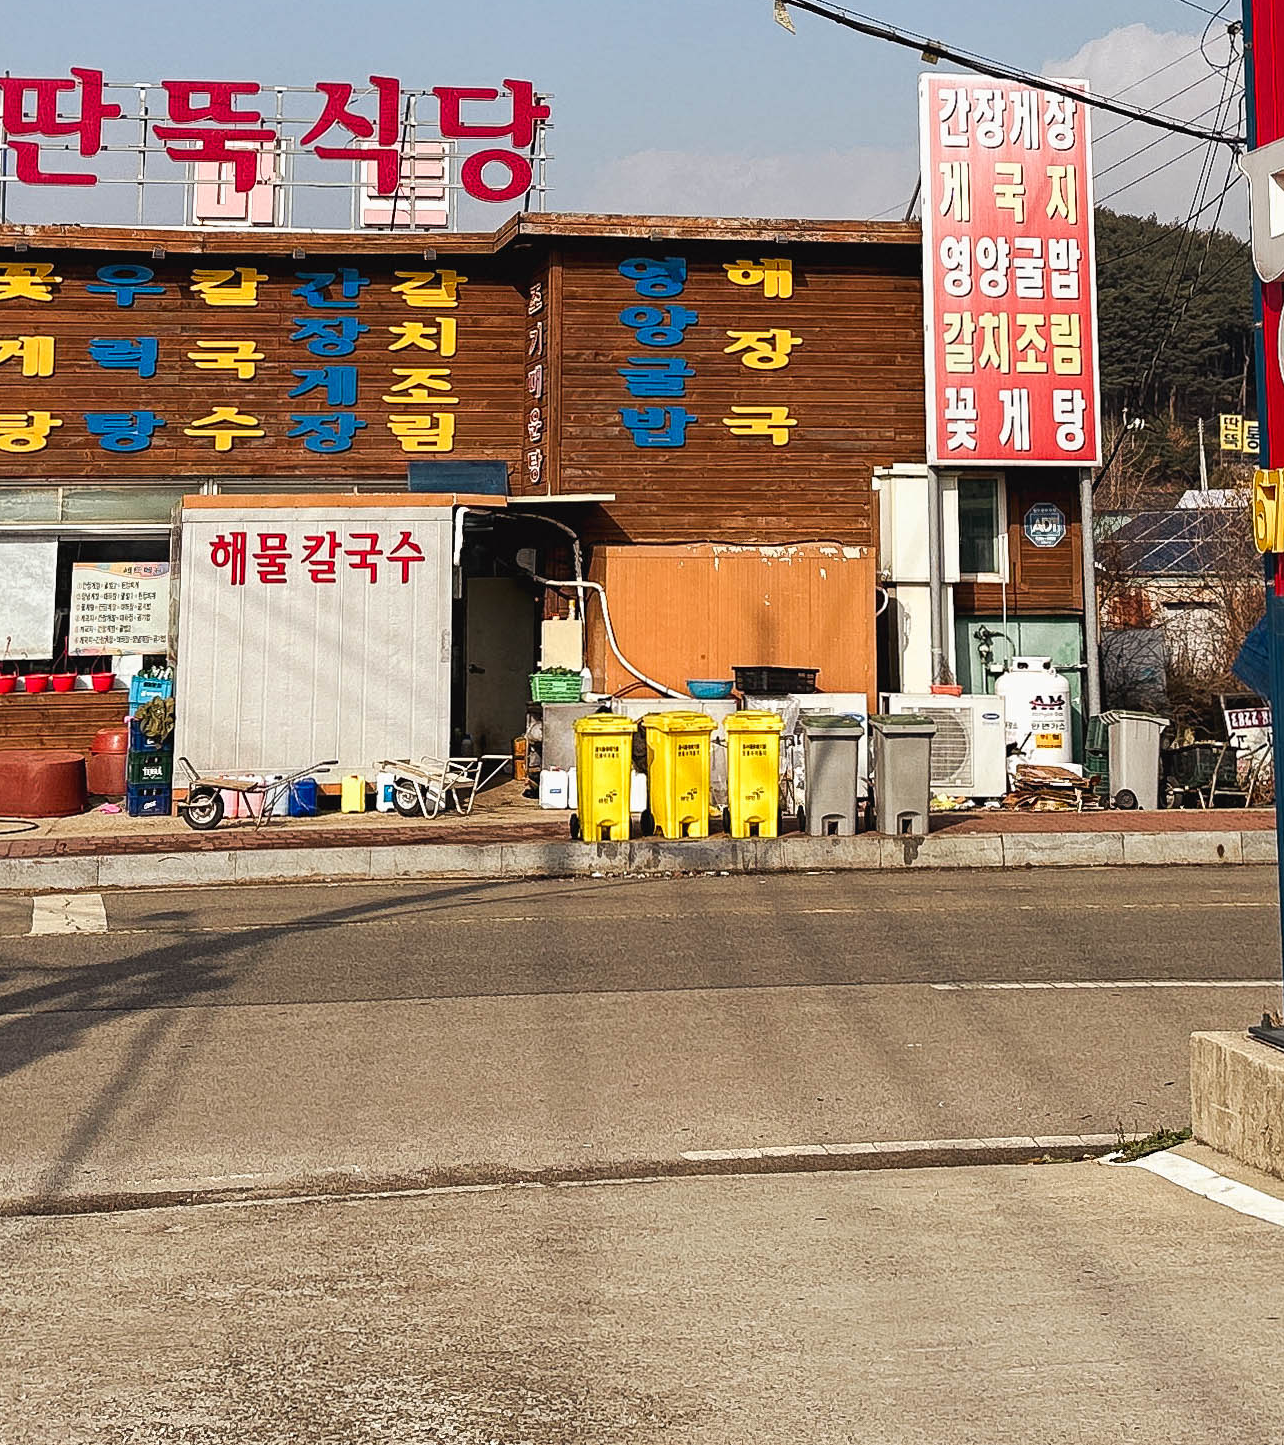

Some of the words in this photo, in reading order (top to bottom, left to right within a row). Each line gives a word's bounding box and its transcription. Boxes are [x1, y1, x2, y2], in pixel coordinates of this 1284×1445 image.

[938, 88, 1077, 151] 간장게장
[939, 161, 1078, 225] 게국지
[939, 236, 1080, 300] 영양굴밥
[84, 264, 166, 452] 우럭탕
[287, 268, 370, 453] 간장게장
[382, 268, 468, 453] 갈치조림
[618, 257, 698, 447] 영양굴밥
[722, 258, 803, 446] 해장국
[942, 311, 1081, 375] 갈치조림
[945, 387, 1086, 453] 꽃게탕
